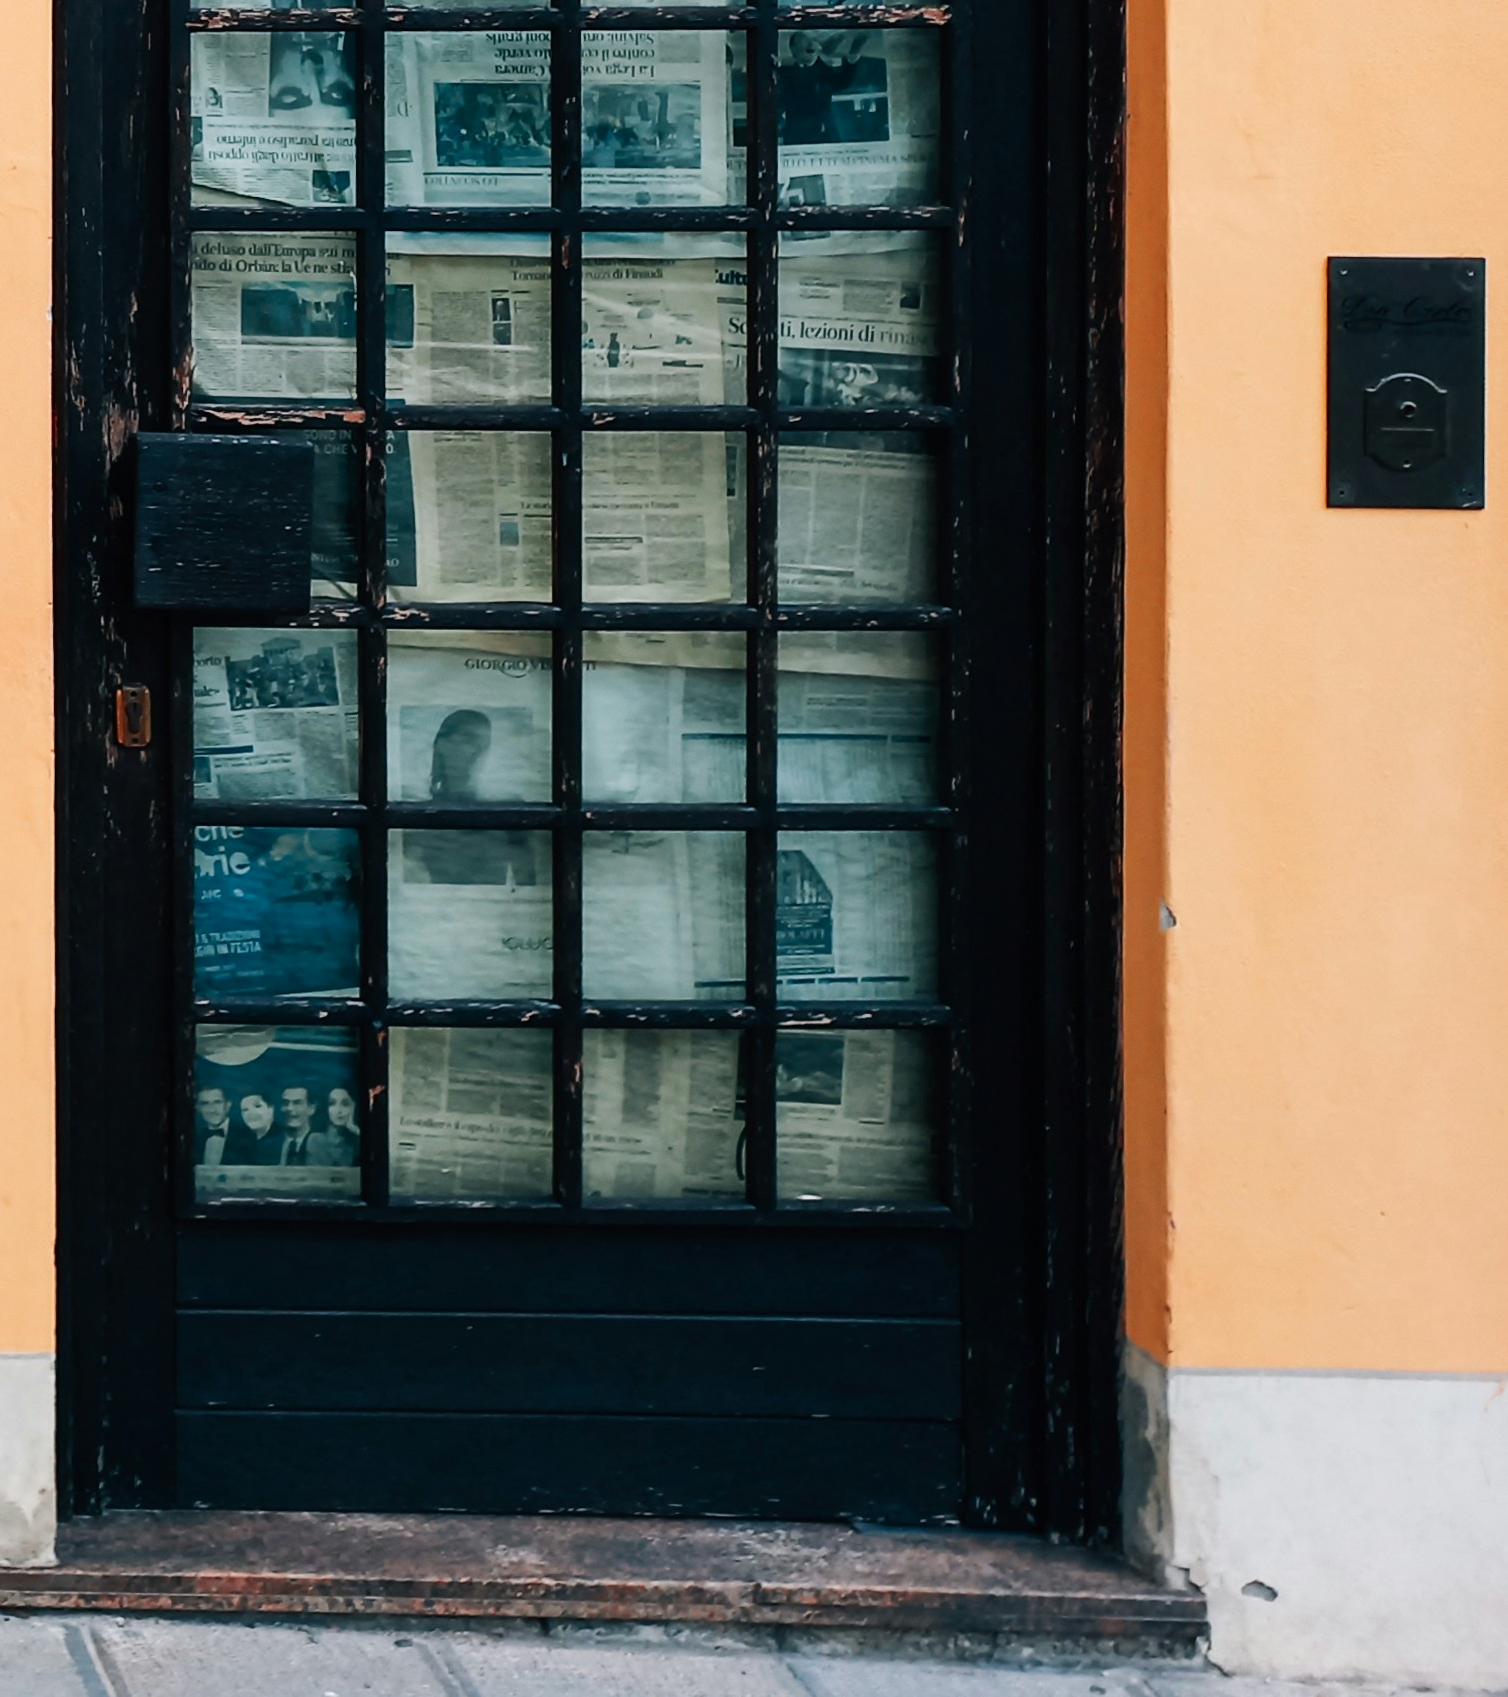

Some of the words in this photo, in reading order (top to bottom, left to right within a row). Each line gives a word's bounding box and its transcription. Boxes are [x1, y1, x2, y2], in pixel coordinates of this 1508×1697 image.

[486, 31, 523, 46] gratis
[495, 49, 530, 62] verde
[602, 49, 609, 61] il
[495, 64, 545, 77] Camera
[605, 64, 635, 77] Lega
[639, 65, 654, 77] La
[201, 243, 245, 256] deluso
[215, 259, 232, 272] di
[800, 321, 854, 341] lezioni
[858, 321, 876, 341] di
